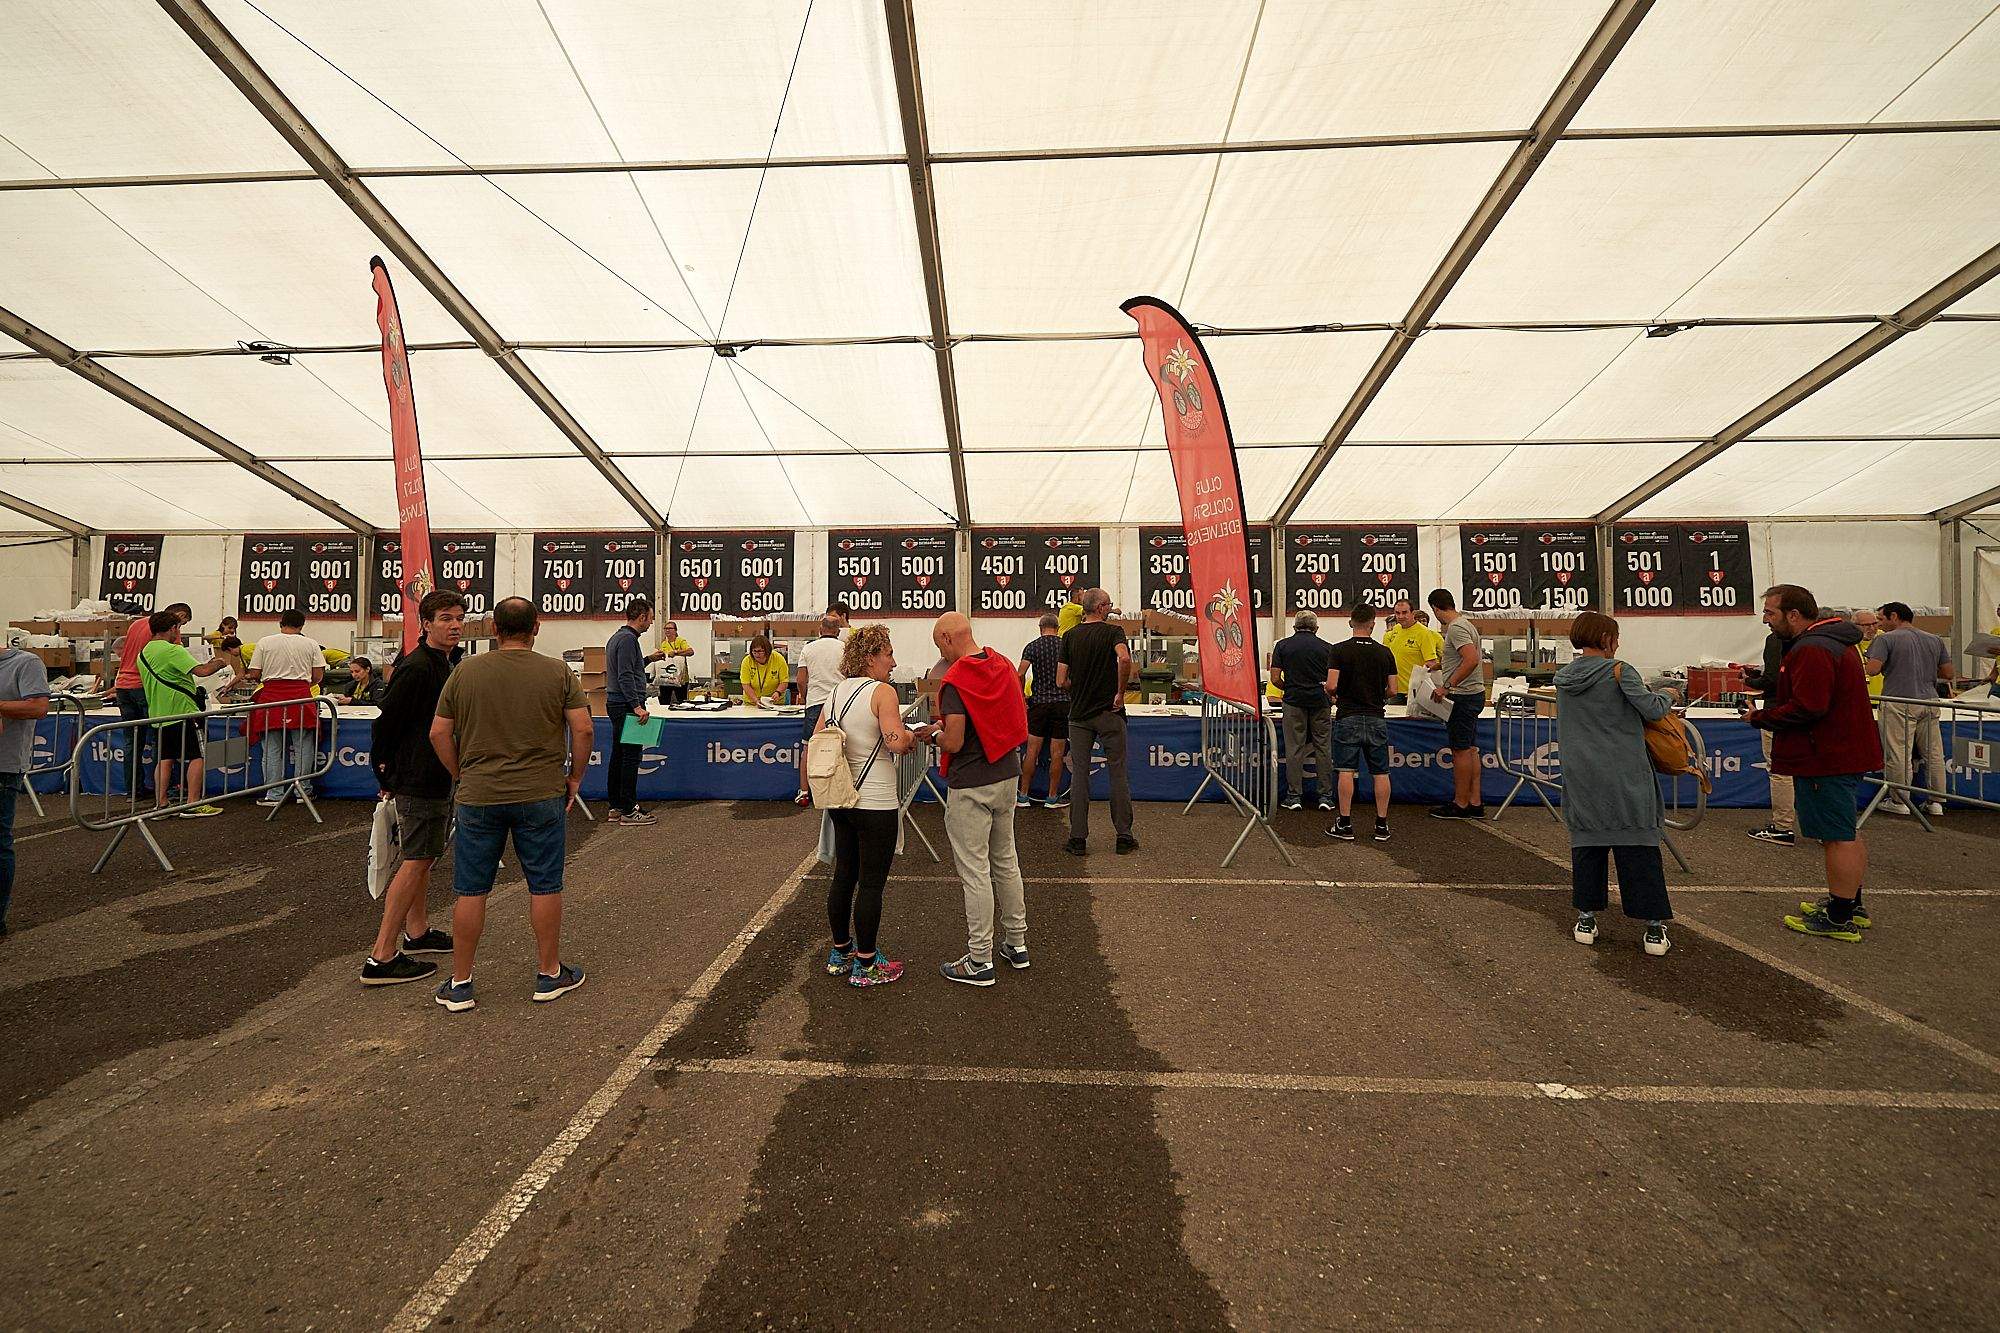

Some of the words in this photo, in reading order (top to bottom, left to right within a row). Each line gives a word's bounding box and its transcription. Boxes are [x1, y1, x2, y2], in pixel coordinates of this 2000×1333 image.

[250, 560, 290, 579] 9501
[310, 560, 350, 579] 9001
[382, 560, 402, 578] 85
[442, 560, 484, 578] 8001
[544, 560, 582, 578] 7501
[605, 559, 644, 578] 7001
[680, 558, 721, 577] 6501
[741, 558, 783, 577] 6001
[838, 556, 880, 576] 5501
[901, 556, 944, 576] 5001
[981, 555, 1024, 575] 4501
[1045, 555, 1088, 574] 4001
[1295, 553, 1340, 573] 2501
[1361, 553, 1406, 573] 2001
[1472, 552, 1517, 572] 1501
[1540, 552, 1585, 571] 1001
[1628, 551, 1662, 571] 501
[1710, 551, 1719, 570] 1
[108, 561, 156, 580] 10001
[1170, 575, 1176, 584] a
[1316, 574, 1322, 584] a
[1382, 574, 1388, 583] a
[1492, 573, 1499, 583] a
[1560, 573, 1567, 582] a
[1643, 572, 1650, 582] a
[1713, 572, 1720, 582] a
[127, 581, 132, 590] a
[266, 580, 272, 590] a
[328, 580, 334, 589] a
[460, 580, 466, 589] a
[561, 580, 566, 589] a
[622, 579, 628, 587] a
[698, 578, 704, 587] a
[760, 578, 765, 587] a
[856, 577, 863, 586] a
[921, 576, 927, 586] a
[1001, 576, 1007, 586] a
[1065, 576, 1071, 585] a
[244, 594, 296, 612] 10000
[309, 594, 351, 612] 9500
[542, 594, 584, 612] 8000
[680, 592, 722, 611] 7000
[740, 592, 784, 611] 6500
[838, 591, 882, 610] 6000
[902, 590, 946, 610] 5500
[981, 590, 1026, 609] 5000
[1150, 589, 1195, 608] 4000
[1296, 588, 1342, 608] 3000
[1473, 588, 1521, 608] 2000
[1542, 587, 1588, 607] 1500
[1624, 587, 1672, 606] 1000
[1700, 587, 1736, 606] 500
[708, 742, 800, 768] iberCaj
